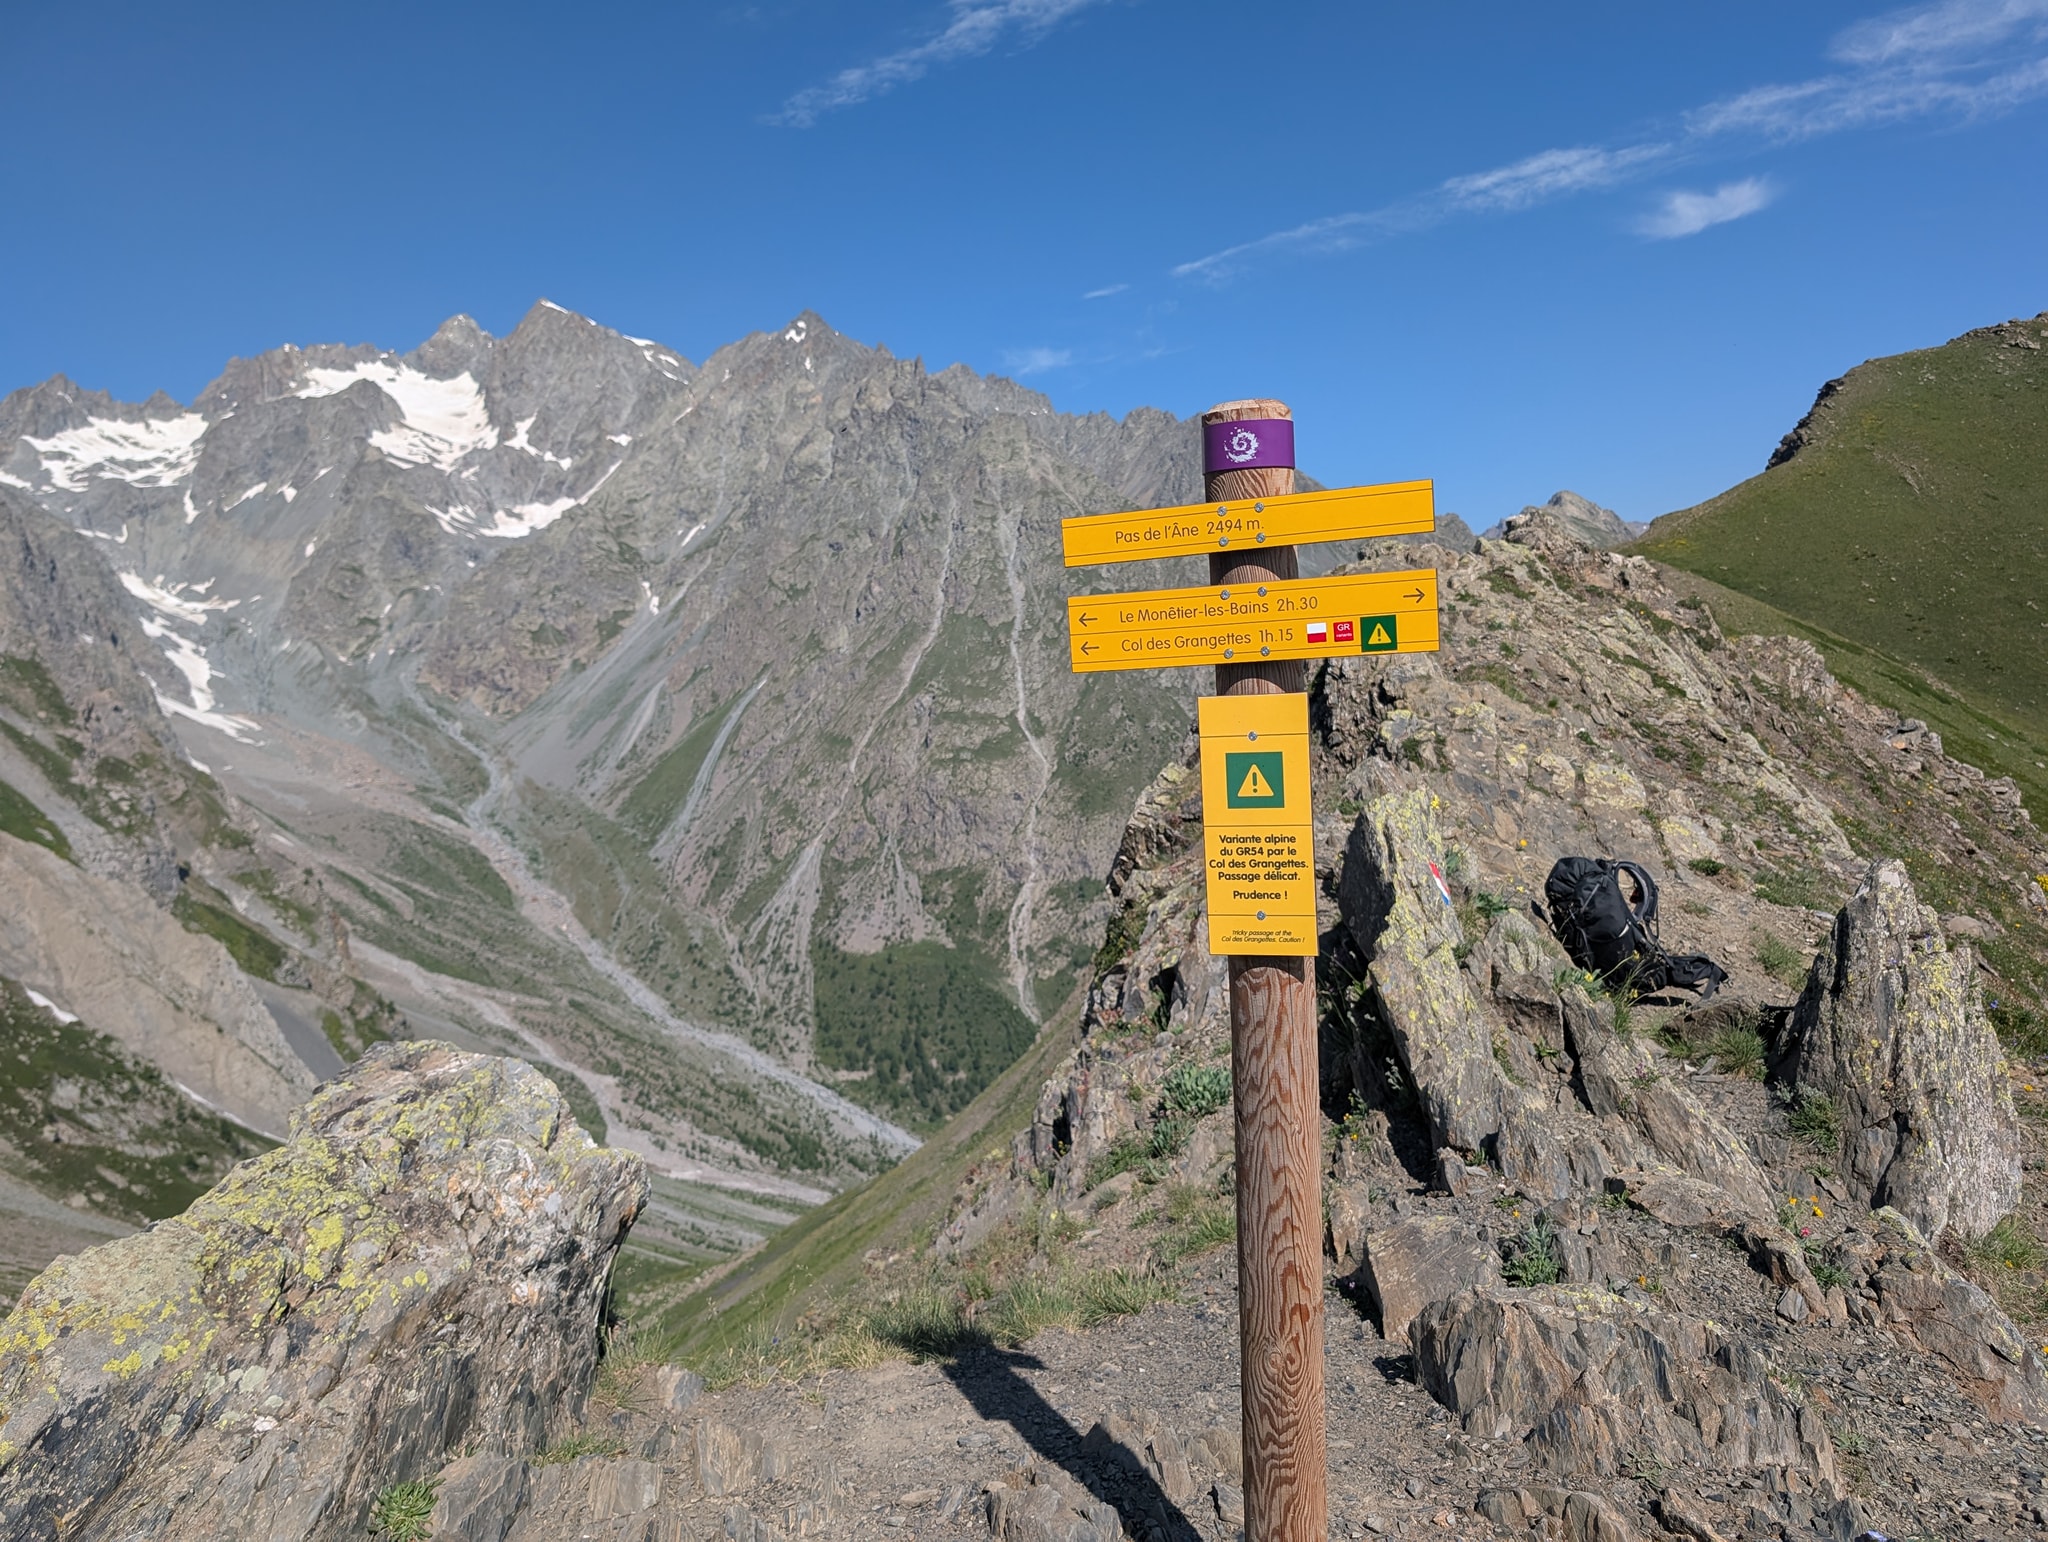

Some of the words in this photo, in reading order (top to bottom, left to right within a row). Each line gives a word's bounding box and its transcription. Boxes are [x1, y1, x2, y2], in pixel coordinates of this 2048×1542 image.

[1115, 530, 1140, 544] Pas
[1143, 527, 1161, 541] de
[1207, 519, 1242, 535] 2494
[1246, 517, 1264, 531] m.
[1120, 610, 1134, 623] Le
[1138, 601, 1269, 621] Monêtier-les-Bains
[1277, 596, 1318, 612] 2h.30
[1121, 638, 1143, 652] Col
[1146, 636, 1171, 650] des
[1174, 631, 1251, 652] Grangettes
[1259, 628, 1293, 643] 1h.15
[1219, 835, 1261, 843] Variante
[1265, 834, 1296, 845] alpine
[1220, 848, 1232, 856] du
[1236, 847, 1264, 856] GR54
[1267, 848, 1285, 857] par
[1287, 847, 1297, 855] le
[1209, 859, 1225, 868] Col
[1228, 859, 1246, 868] des
[1249, 859, 1308, 870] Grangettes.
[1218, 872, 1260, 882] Passage
[1264, 872, 1300, 880] délicat.
[1233, 891, 1281, 899] Prudence
[1284, 891, 1288, 899] !
[1248, 930, 1274, 938] passage
